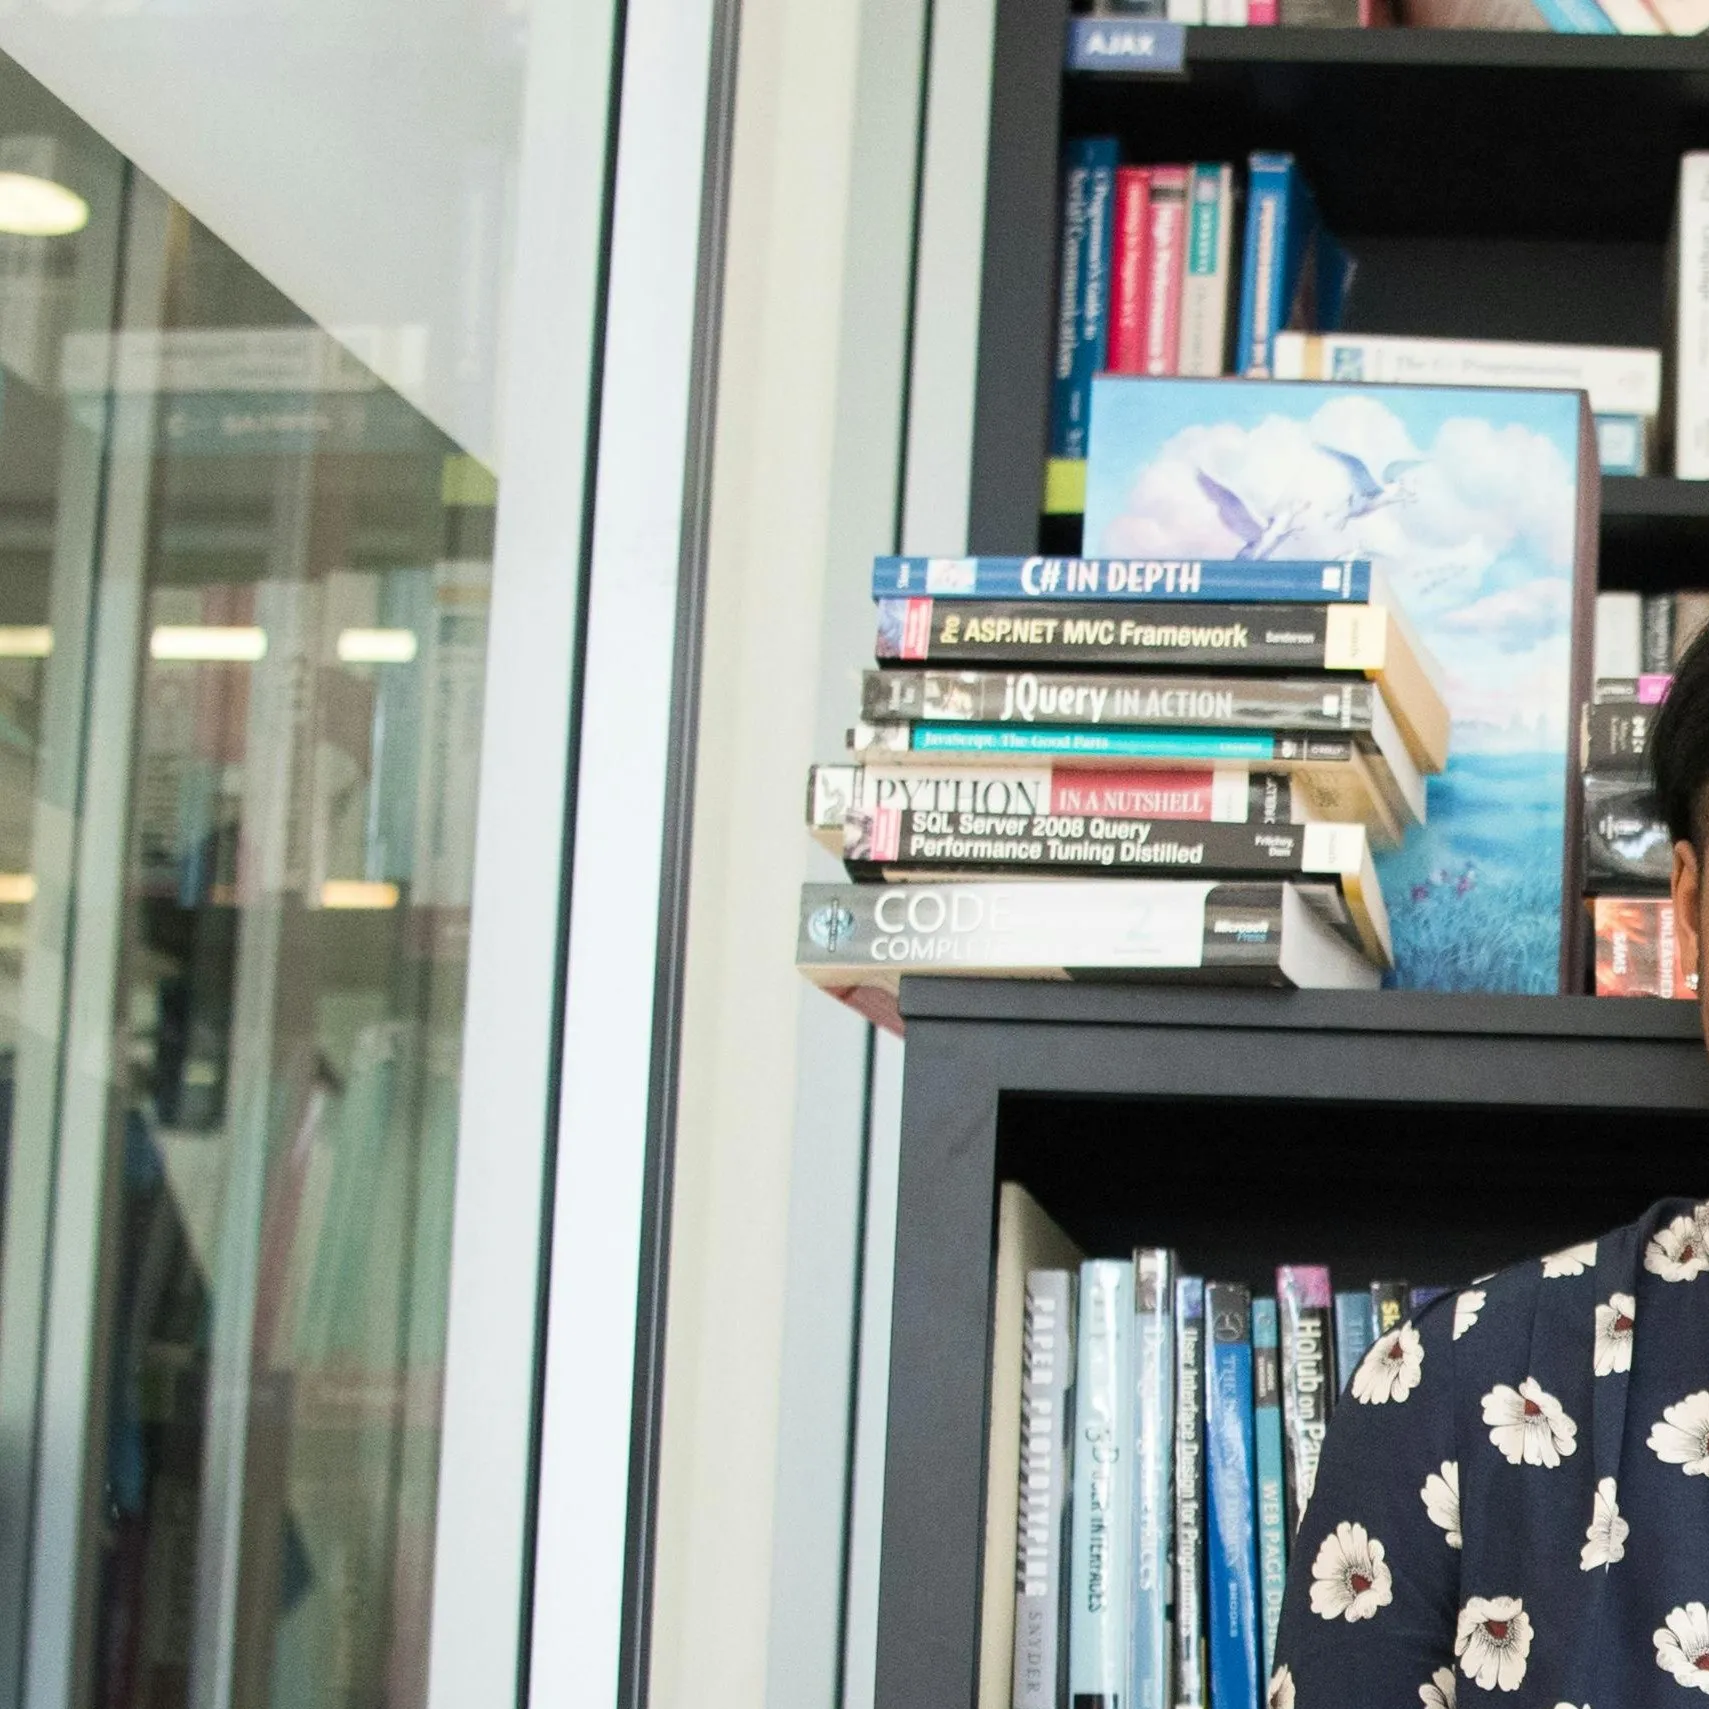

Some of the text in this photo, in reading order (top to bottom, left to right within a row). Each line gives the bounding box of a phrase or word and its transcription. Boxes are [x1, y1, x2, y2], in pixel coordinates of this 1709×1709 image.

[1087, 32, 1156, 58] AJAX
[1020, 556, 1202, 596] C# IN DEPTH
[964, 617, 1060, 645] ASP.NET
[1063, 618, 1114, 646] MVC
[1119, 620, 1248, 650] Framework
[1000, 674, 1234, 723] jQuery IN ACTION
[1030, 734, 1070, 750] Good
[1071, 735, 1109, 751] Parts
[876, 778, 1205, 814] PYTHON IN A NUTSHELL
[910, 835, 1204, 866] Performance Tuning Distilled
[911, 811, 1152, 845] SQL Server 2008 Query
[873, 888, 1014, 935] CODE
[1222, 1353, 1238, 1393] THE
[1297, 1317, 1324, 1420] Holub on
[1181, 1369, 1198, 1441] Interface
[1022, 1296, 1056, 1598] PAPER PROTOTYPING
[1178, 1442, 1198, 1499] Design
[1182, 1501, 1198, 1523] for
[1262, 1479, 1283, 1583] WEB PAGE
[1086, 1516, 1110, 1615] INTERFACES
[1175, 1527, 1199, 1638] Programmers
[1227, 1582, 1239, 1639] BROOKS
[1026, 1610, 1043, 1695] SNYDER
